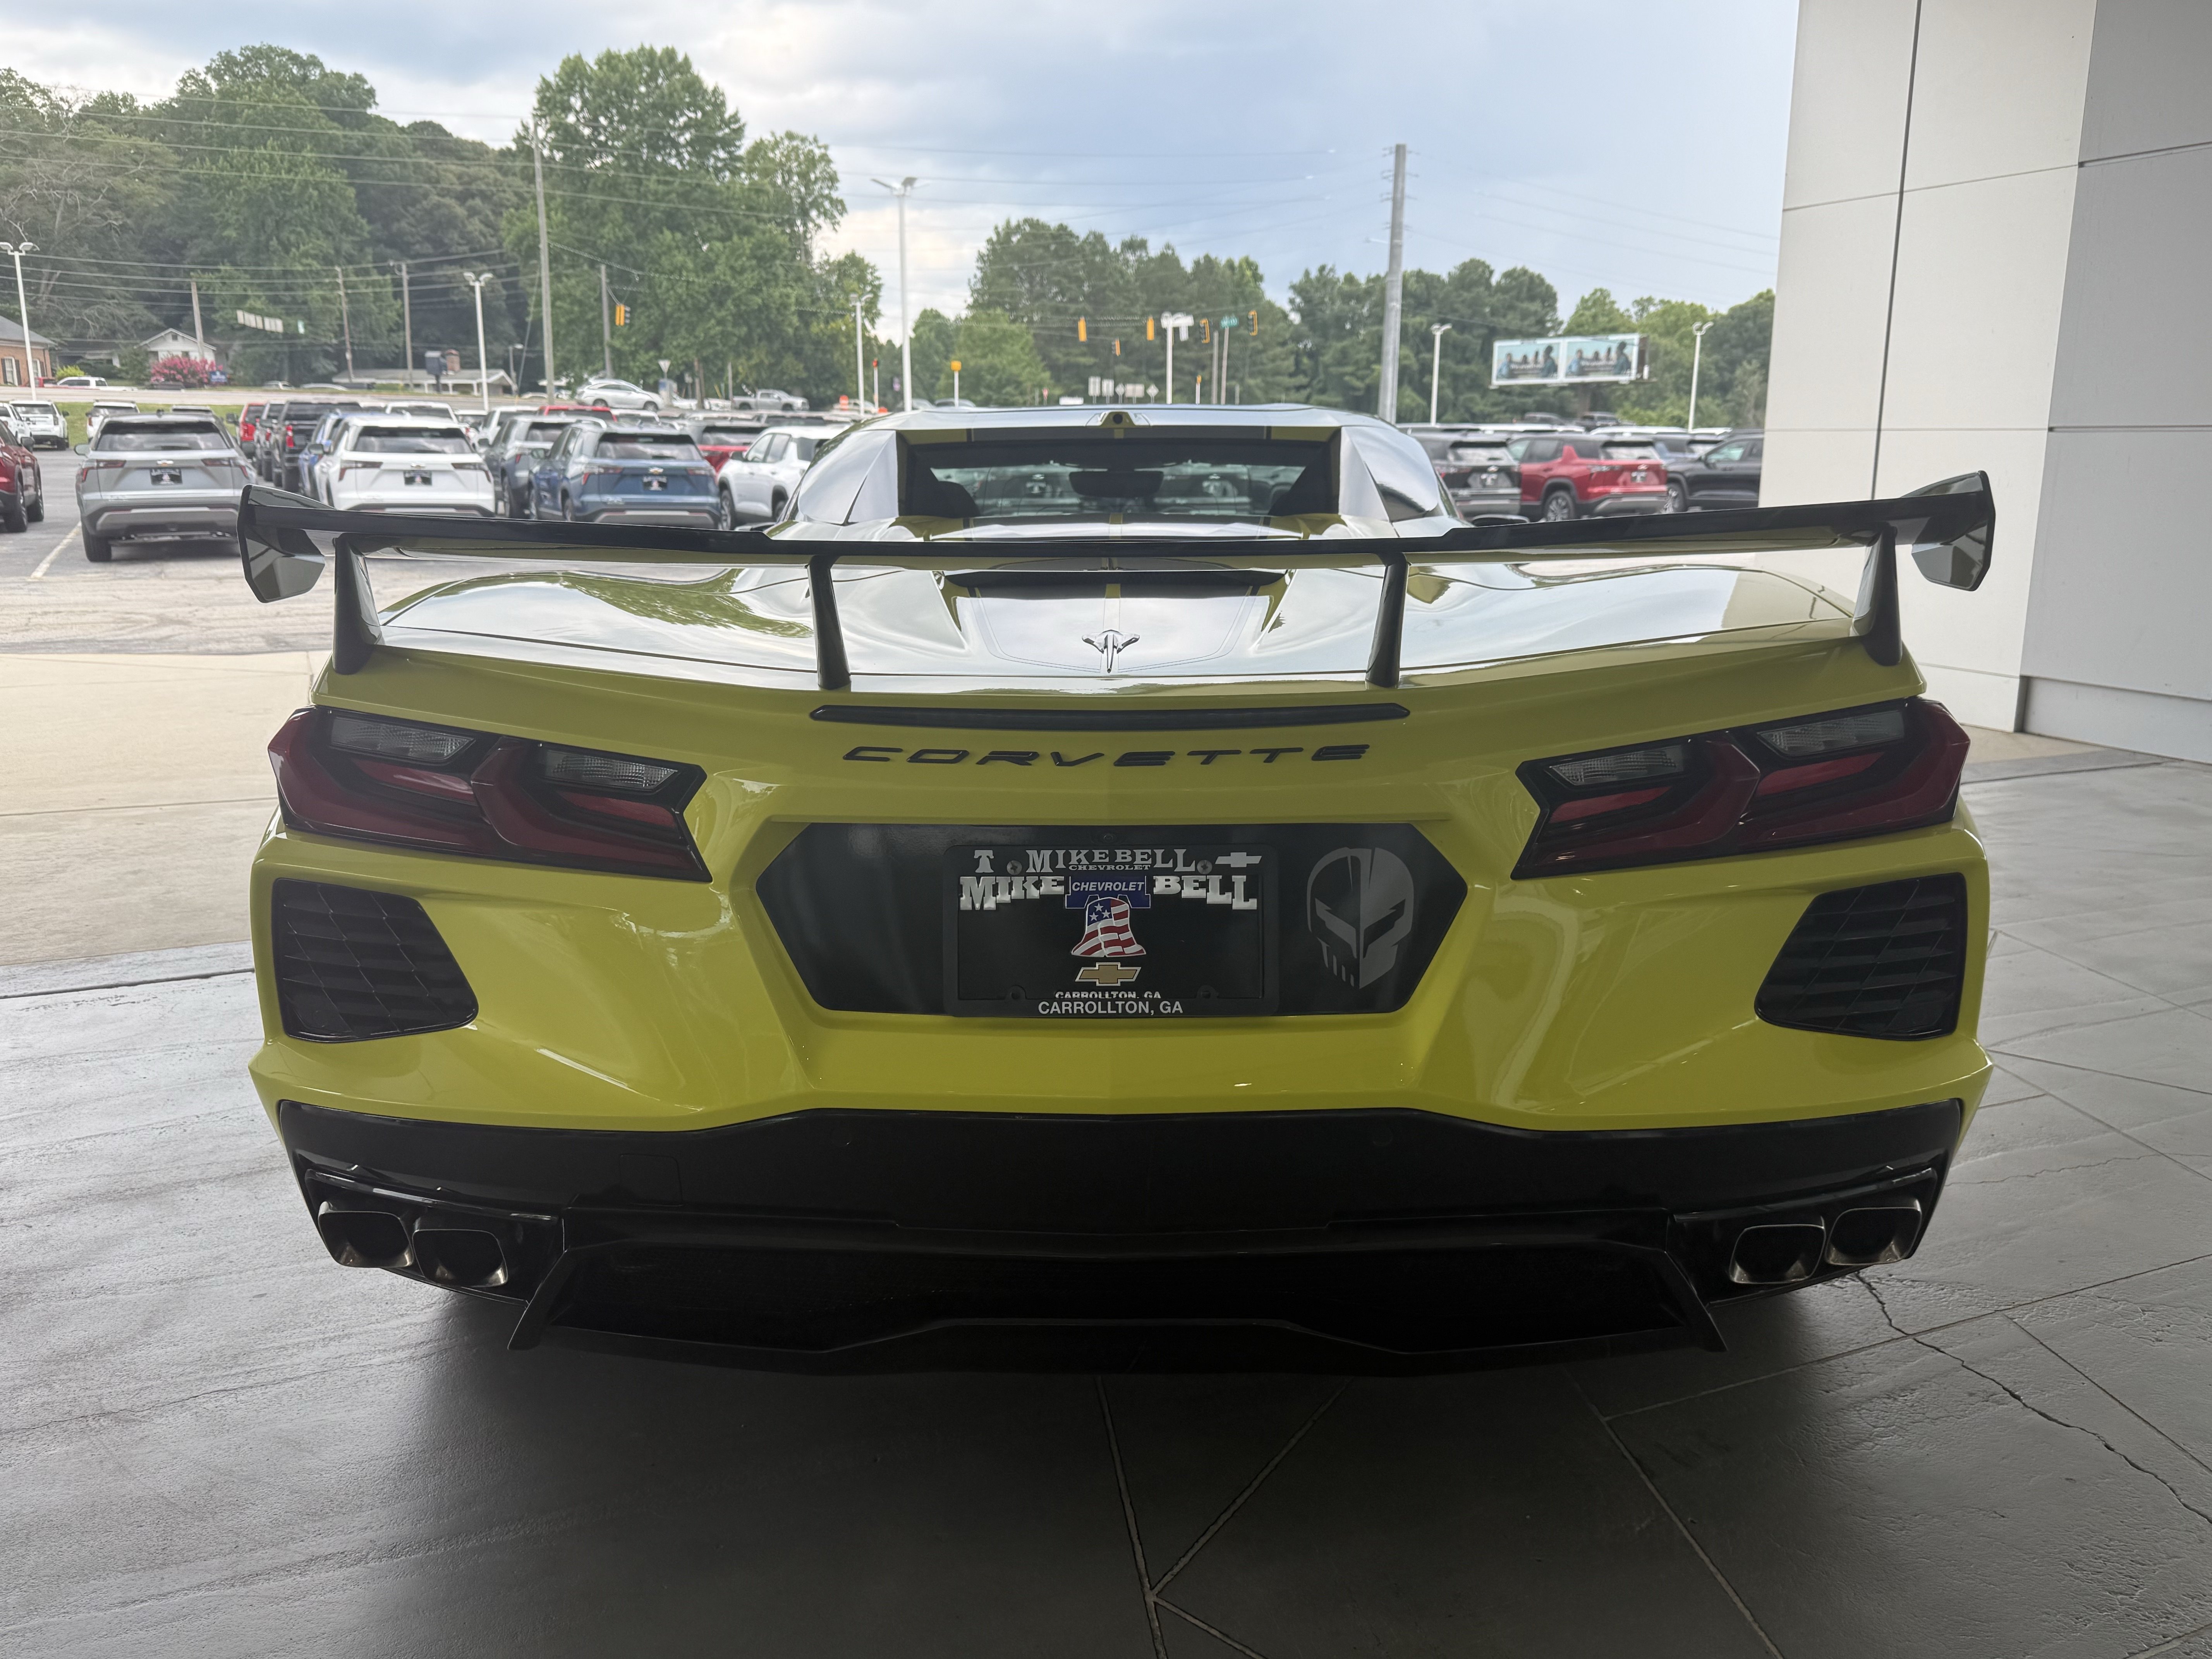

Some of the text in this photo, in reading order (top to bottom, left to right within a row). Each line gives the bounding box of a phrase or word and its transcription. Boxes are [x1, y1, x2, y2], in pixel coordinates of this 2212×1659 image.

[842, 744, 1370, 768] CORVETTE
[1025, 849, 1196, 872] MIKE BELL
[960, 875, 1257, 910] MIKE BELL
[1072, 882, 1144, 891] CHEVROLET
[1038, 1001, 1183, 1015] CARROLLTON, GA
